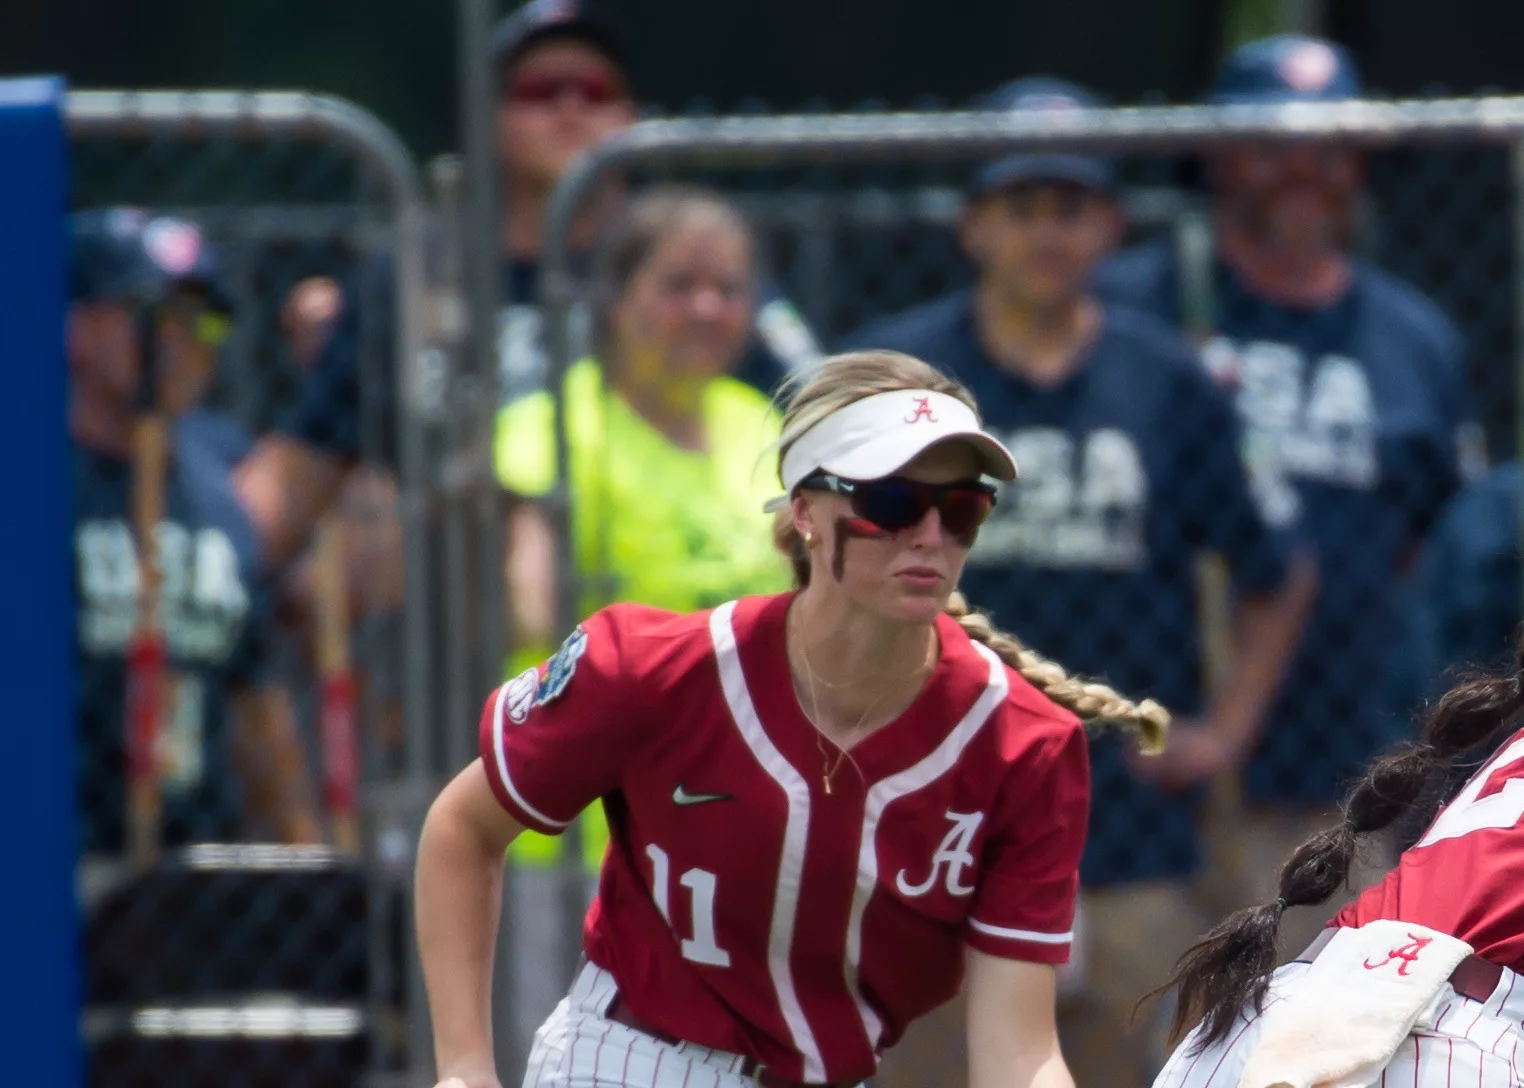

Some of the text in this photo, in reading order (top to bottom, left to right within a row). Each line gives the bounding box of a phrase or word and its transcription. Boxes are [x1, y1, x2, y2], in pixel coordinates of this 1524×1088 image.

[904, 396, 939, 424] A
[896, 806, 983, 896] A
[1363, 933, 1433, 976] A
